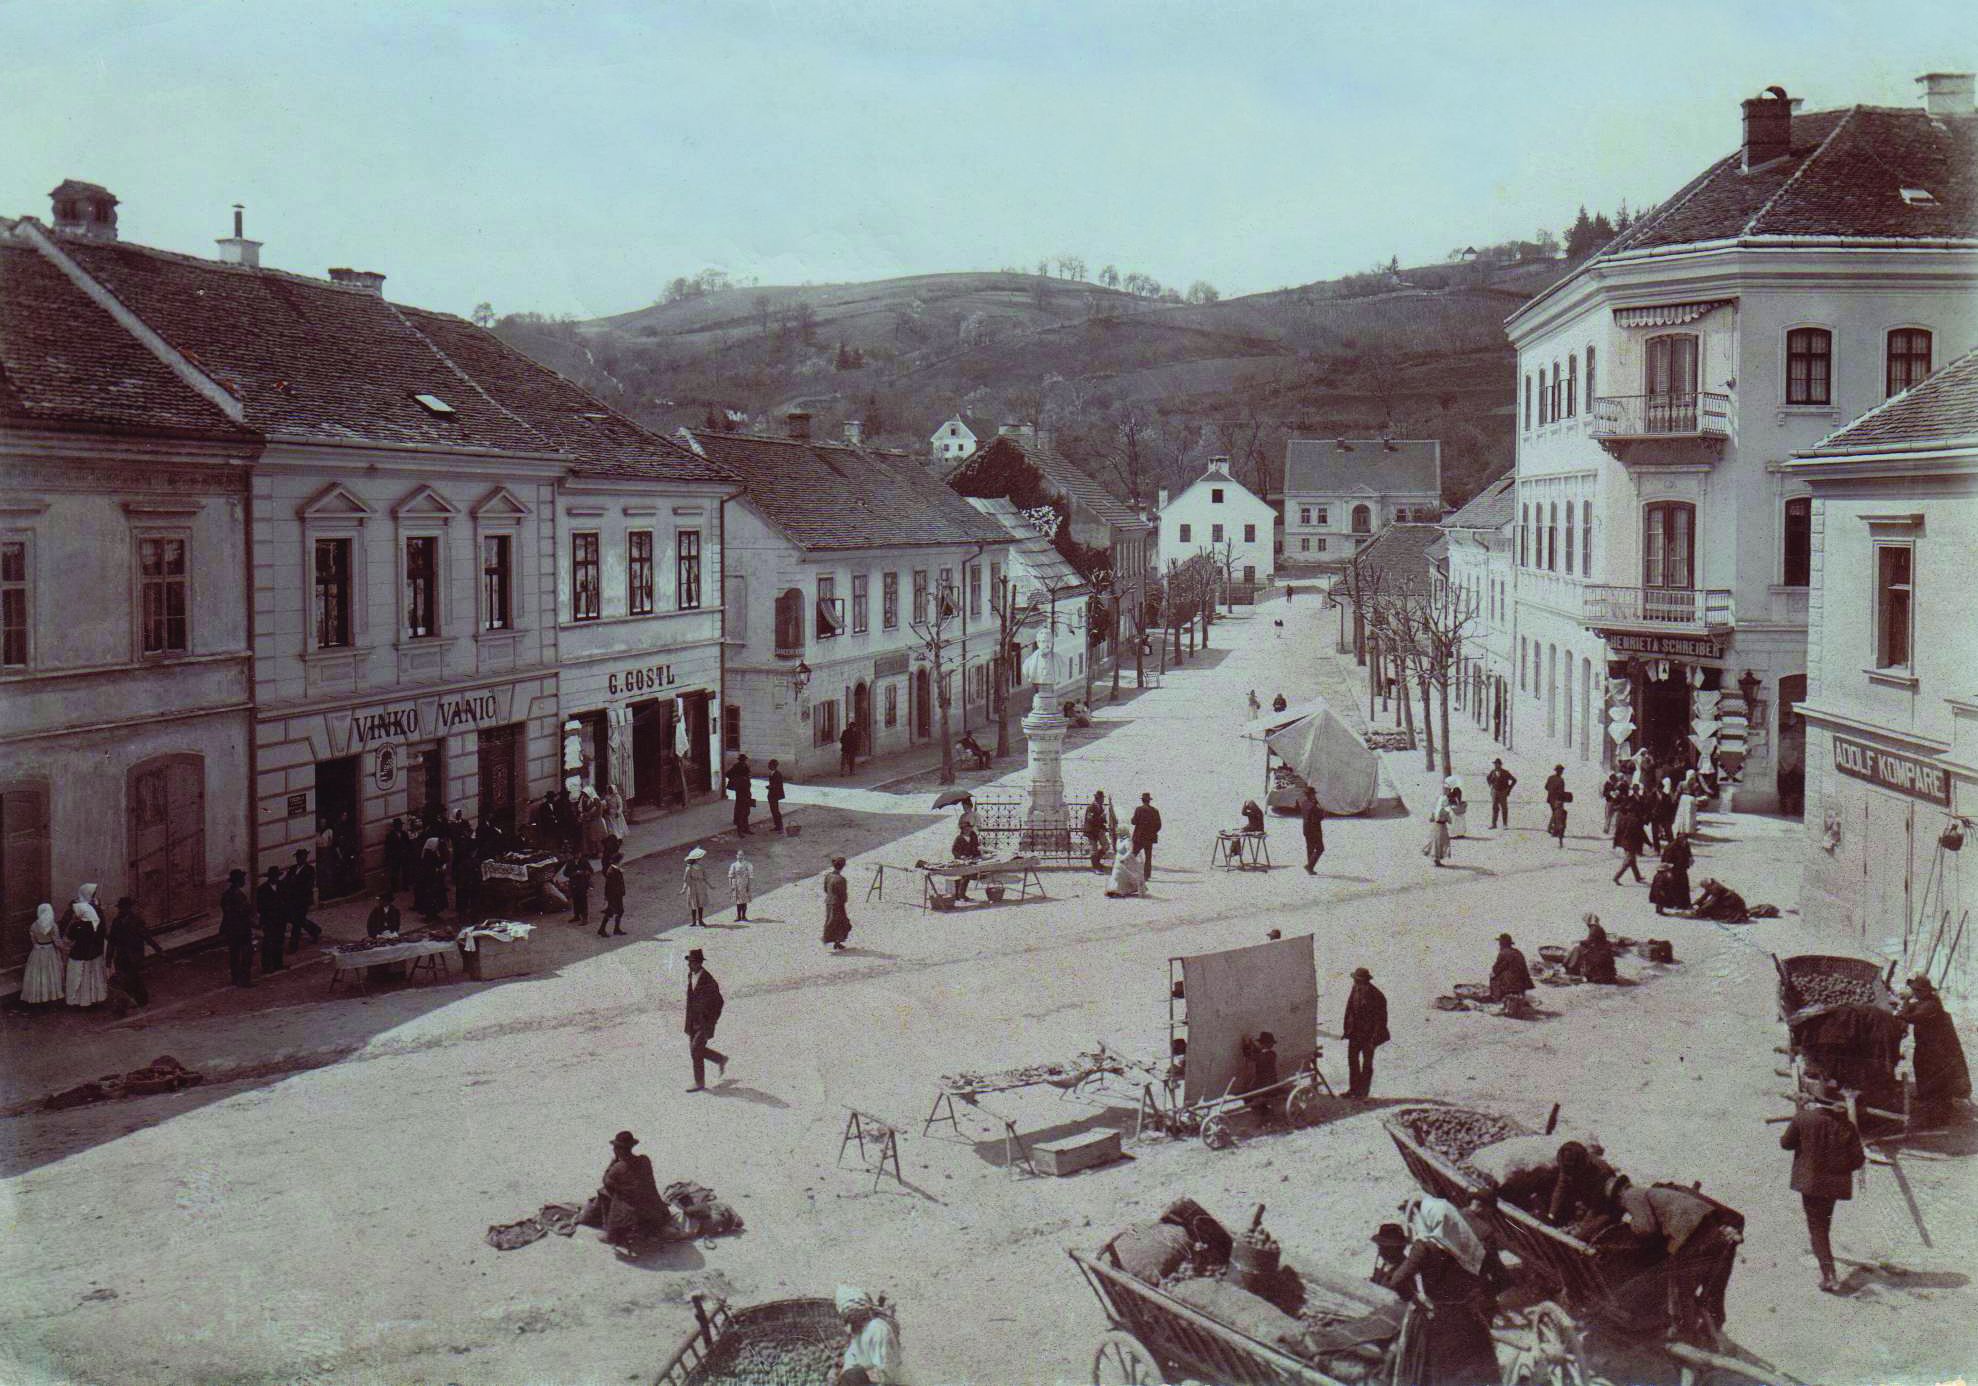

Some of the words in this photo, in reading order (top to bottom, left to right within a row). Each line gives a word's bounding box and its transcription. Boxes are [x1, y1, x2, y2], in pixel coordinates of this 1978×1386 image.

[1611, 635, 1659, 651] HENRIETA
[1662, 639, 1720, 656] SCHREIBER
[354, 708, 418, 743] VINKO
[1836, 740, 1874, 775] ADOLF
[1878, 754, 1945, 799] KOMPARE
